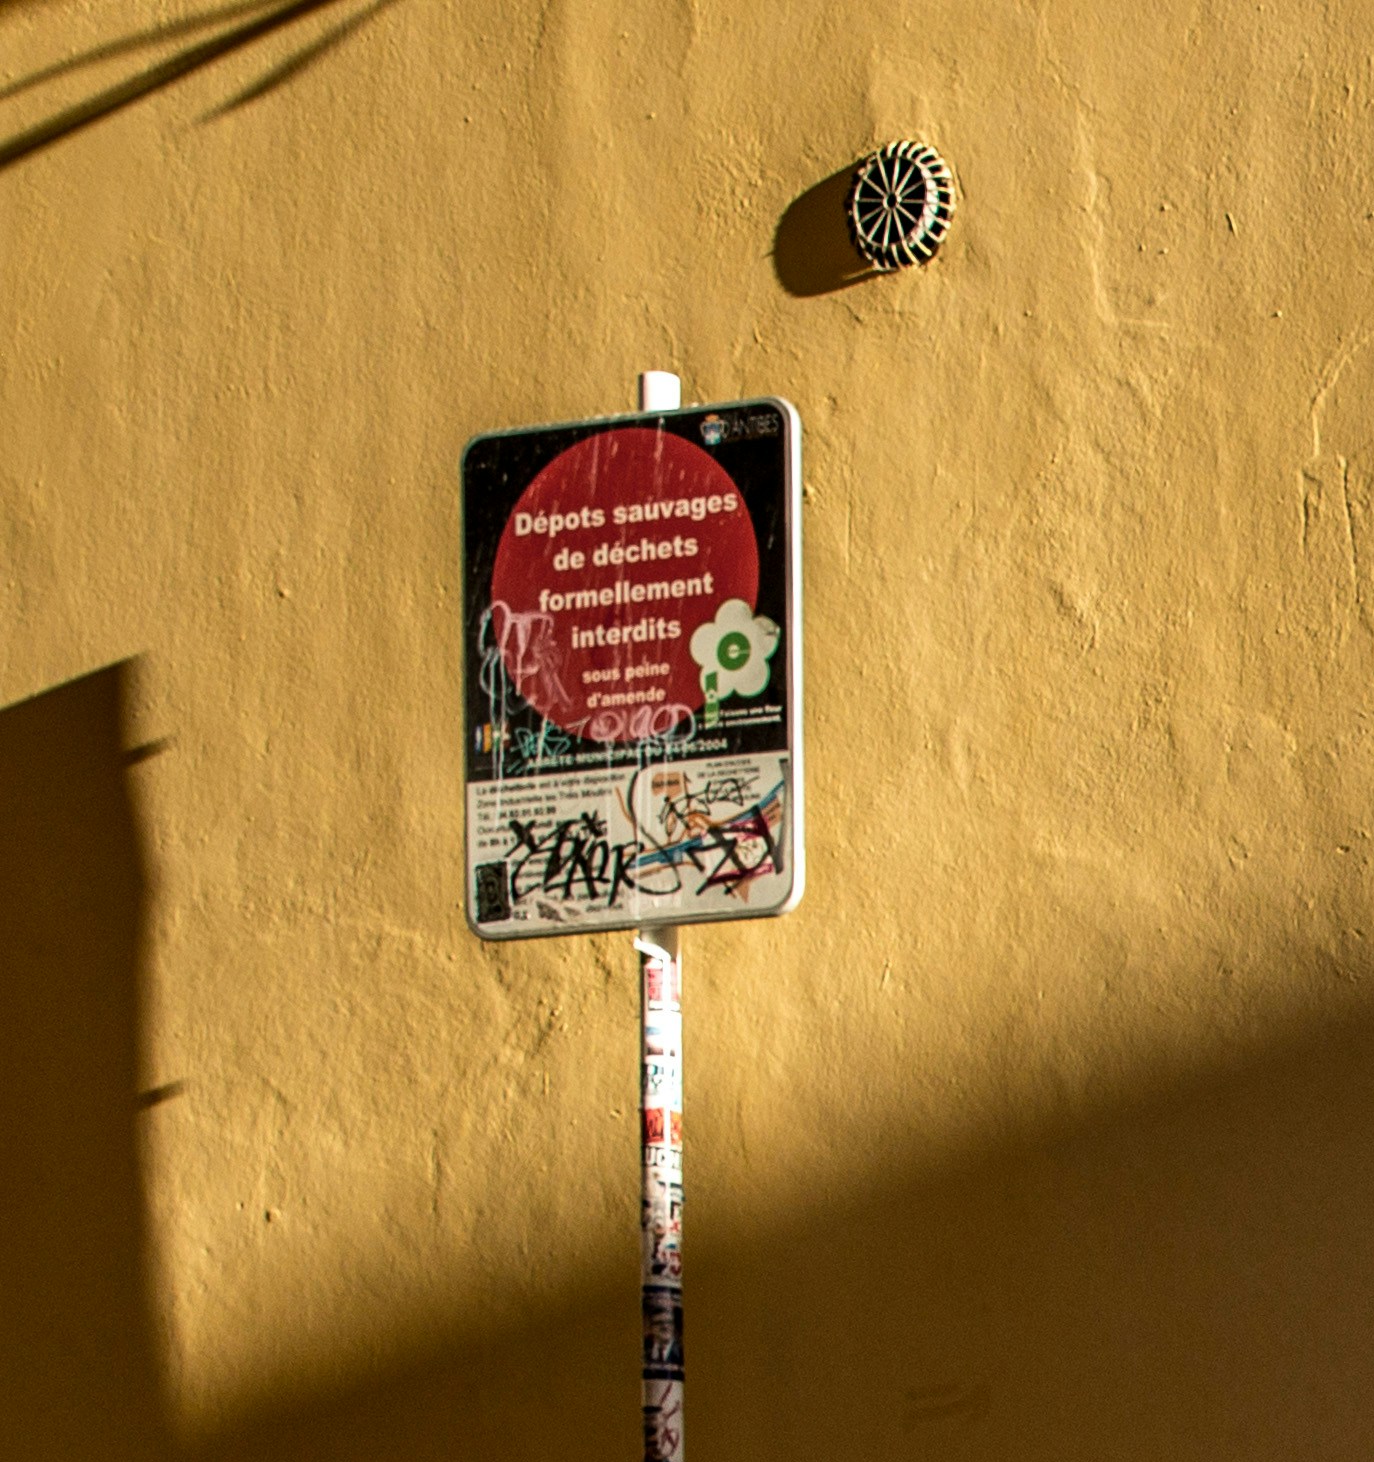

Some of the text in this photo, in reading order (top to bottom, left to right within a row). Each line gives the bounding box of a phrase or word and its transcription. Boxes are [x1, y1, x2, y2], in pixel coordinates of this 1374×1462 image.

[514, 492, 739, 537] Dépots sauvages
[553, 534, 699, 572] de déchets
[538, 571, 714, 613] formellement
[571, 616, 682, 649] interdits
[582, 660, 671, 684] sous peine
[586, 685, 667, 709] d'amende
